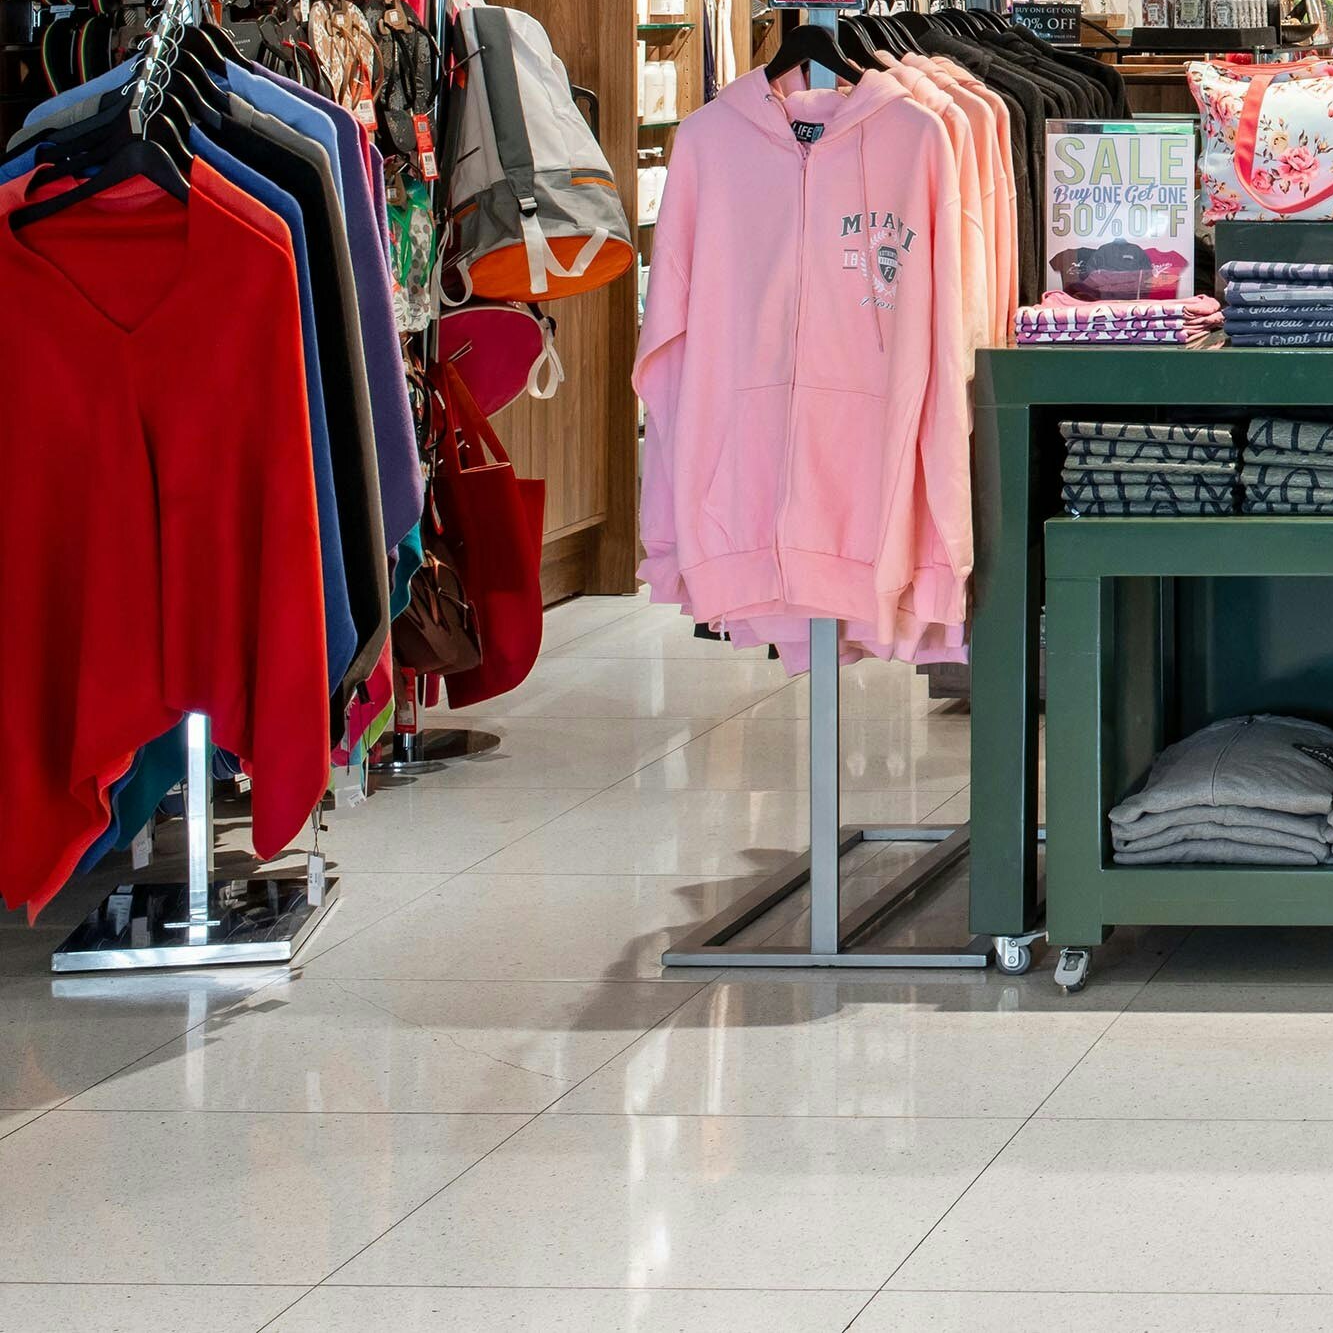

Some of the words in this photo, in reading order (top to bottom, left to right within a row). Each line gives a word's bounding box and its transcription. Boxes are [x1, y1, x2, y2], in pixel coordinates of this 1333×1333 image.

[1047, 17, 1076, 30] OFF
[1053, 137, 1188, 185] SALE
[1053, 184, 1092, 204] Buy
[1093, 187, 1121, 204] ONE
[1124, 182, 1158, 208] Get
[1159, 187, 1187, 204] ONE
[1052, 203, 1122, 237] 50%
[1128, 203, 1188, 237] OFF
[1270, 334, 1310, 346] Great
